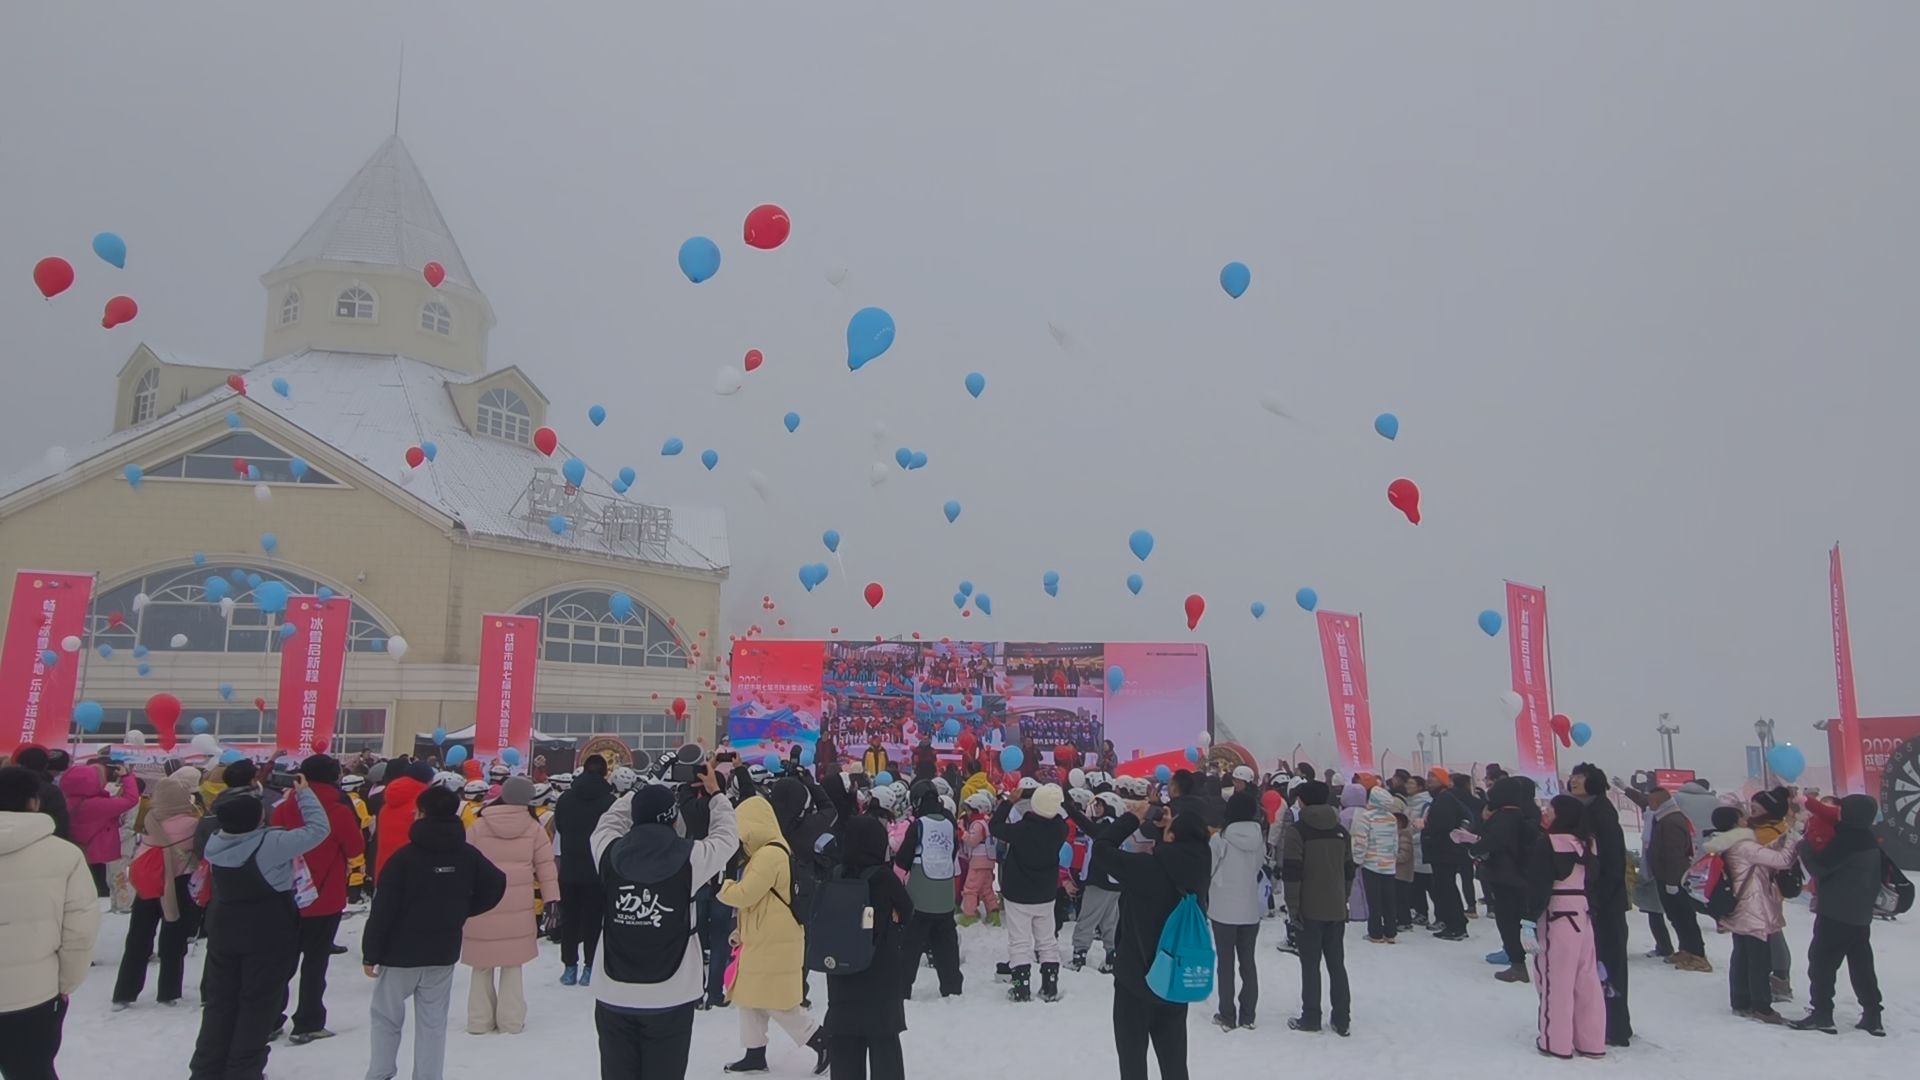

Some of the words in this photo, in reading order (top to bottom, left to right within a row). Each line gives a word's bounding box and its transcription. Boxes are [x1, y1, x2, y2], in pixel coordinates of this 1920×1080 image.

[305, 617, 324, 683] 冰雪启新程
[299, 689, 318, 755] 燃情向未来
[1906, 742, 1913, 752] 5
[1883, 803, 1889, 813] 8
